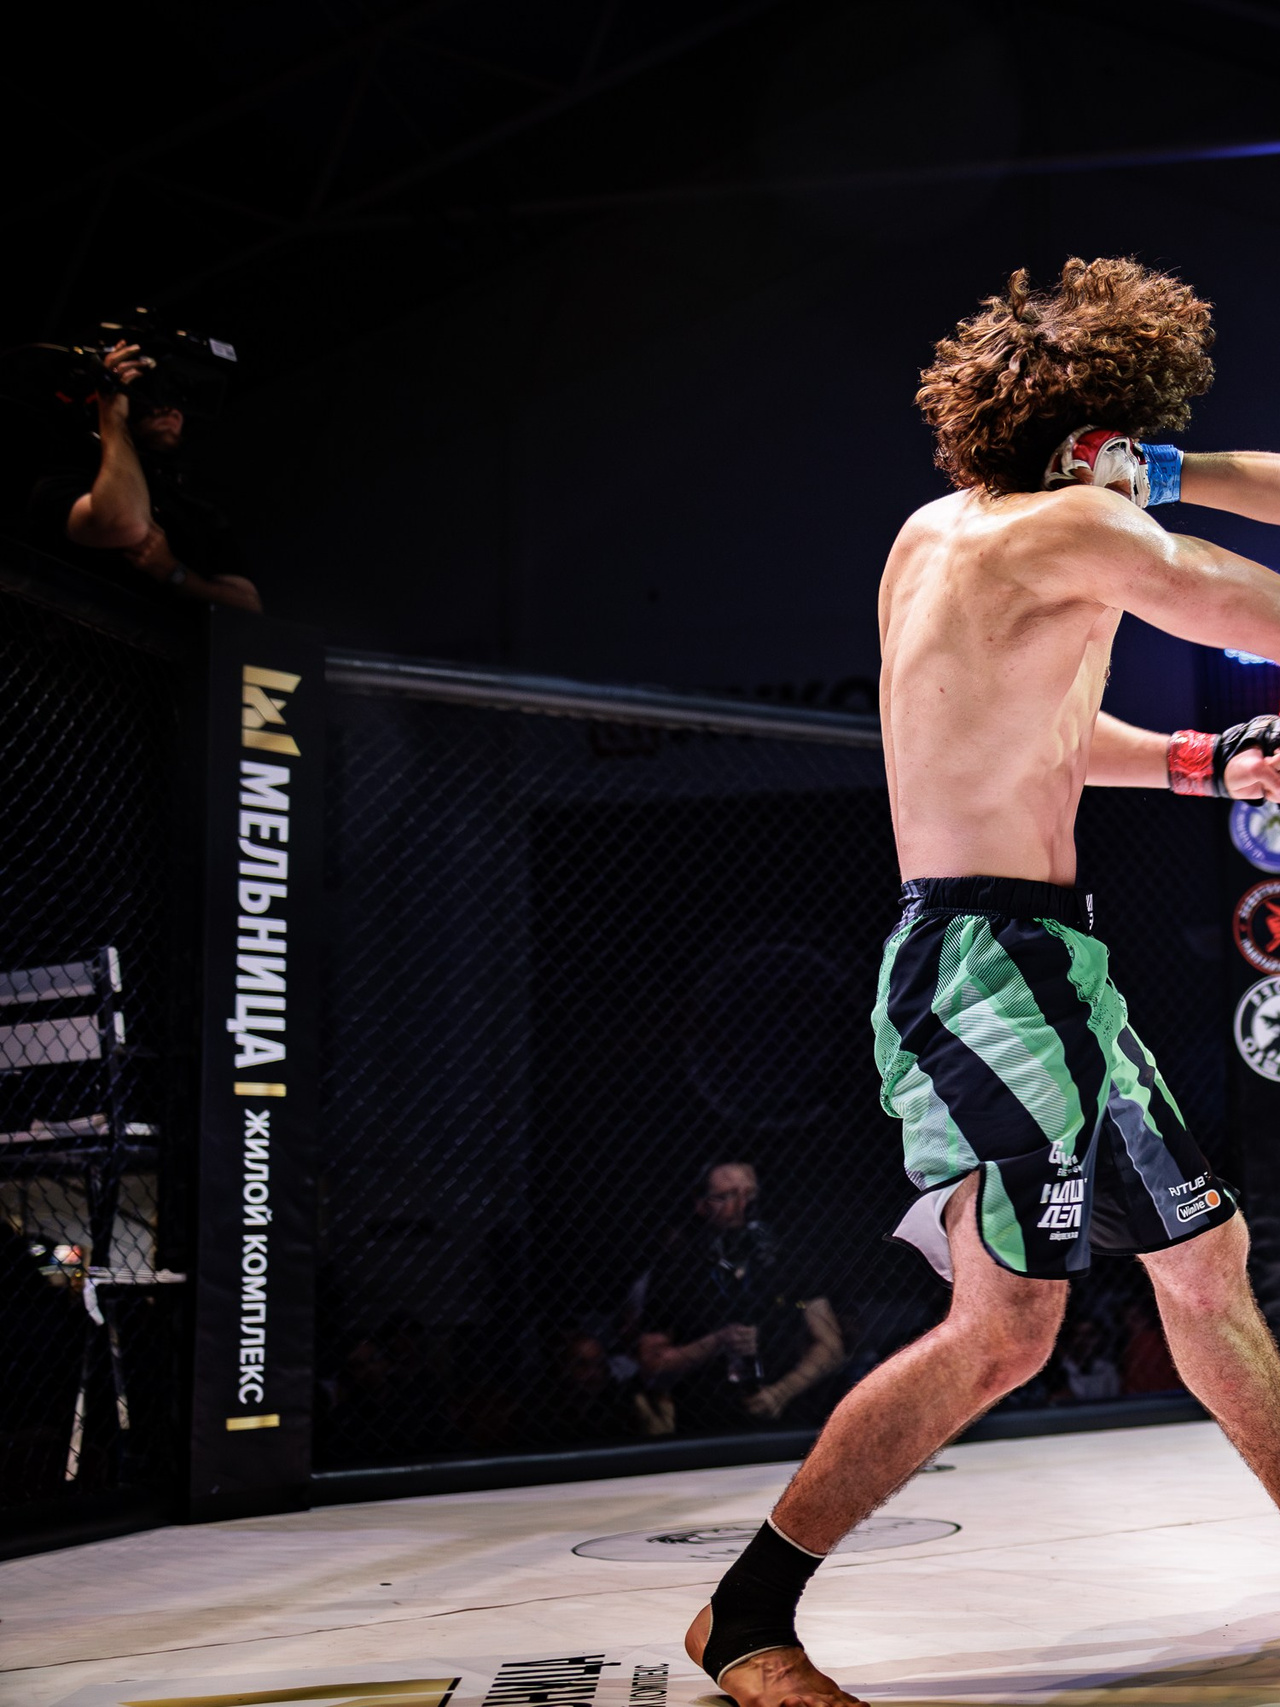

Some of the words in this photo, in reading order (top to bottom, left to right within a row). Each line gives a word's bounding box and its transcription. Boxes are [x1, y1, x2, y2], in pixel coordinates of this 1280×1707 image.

[226, 759, 291, 1070] МЕЛЬНИЦА
[242, 1107, 273, 1226] ЖИЛОЙ
[237, 1233, 269, 1405] КОМПЛЕКС
